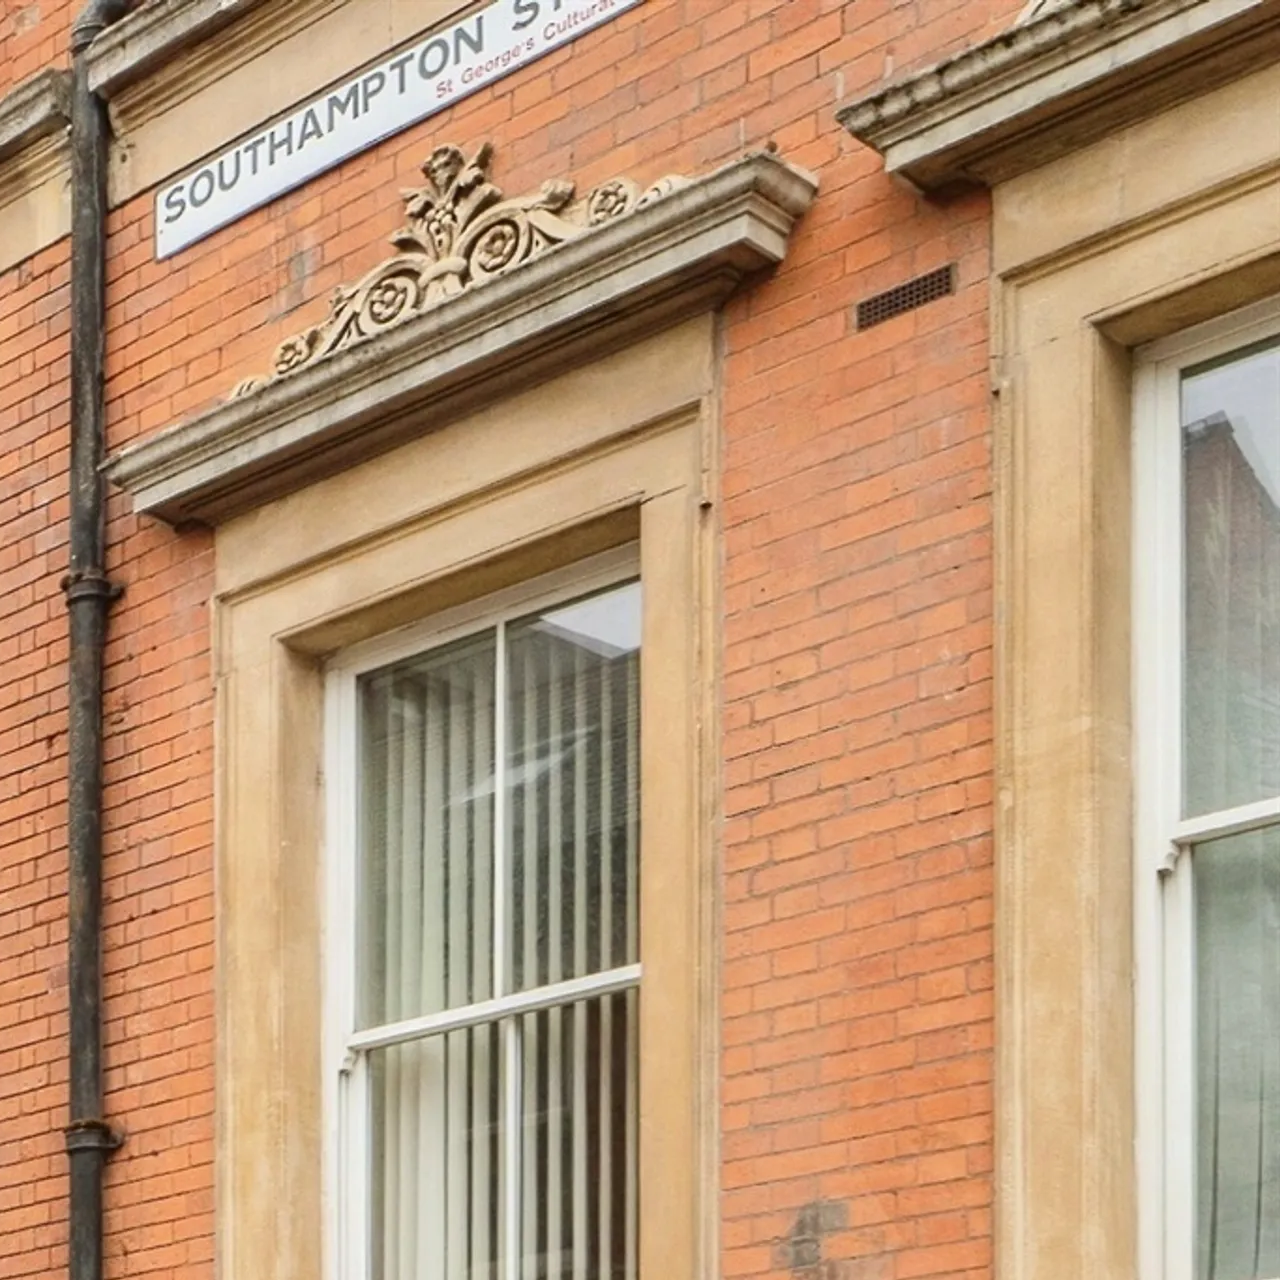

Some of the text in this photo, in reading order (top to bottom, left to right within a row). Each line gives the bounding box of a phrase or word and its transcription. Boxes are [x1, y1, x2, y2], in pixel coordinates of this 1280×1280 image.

[164, 0, 562, 224] SOUTHAMPTON S
[436, 79, 454, 98] St
[460, 37, 535, 85] George's
